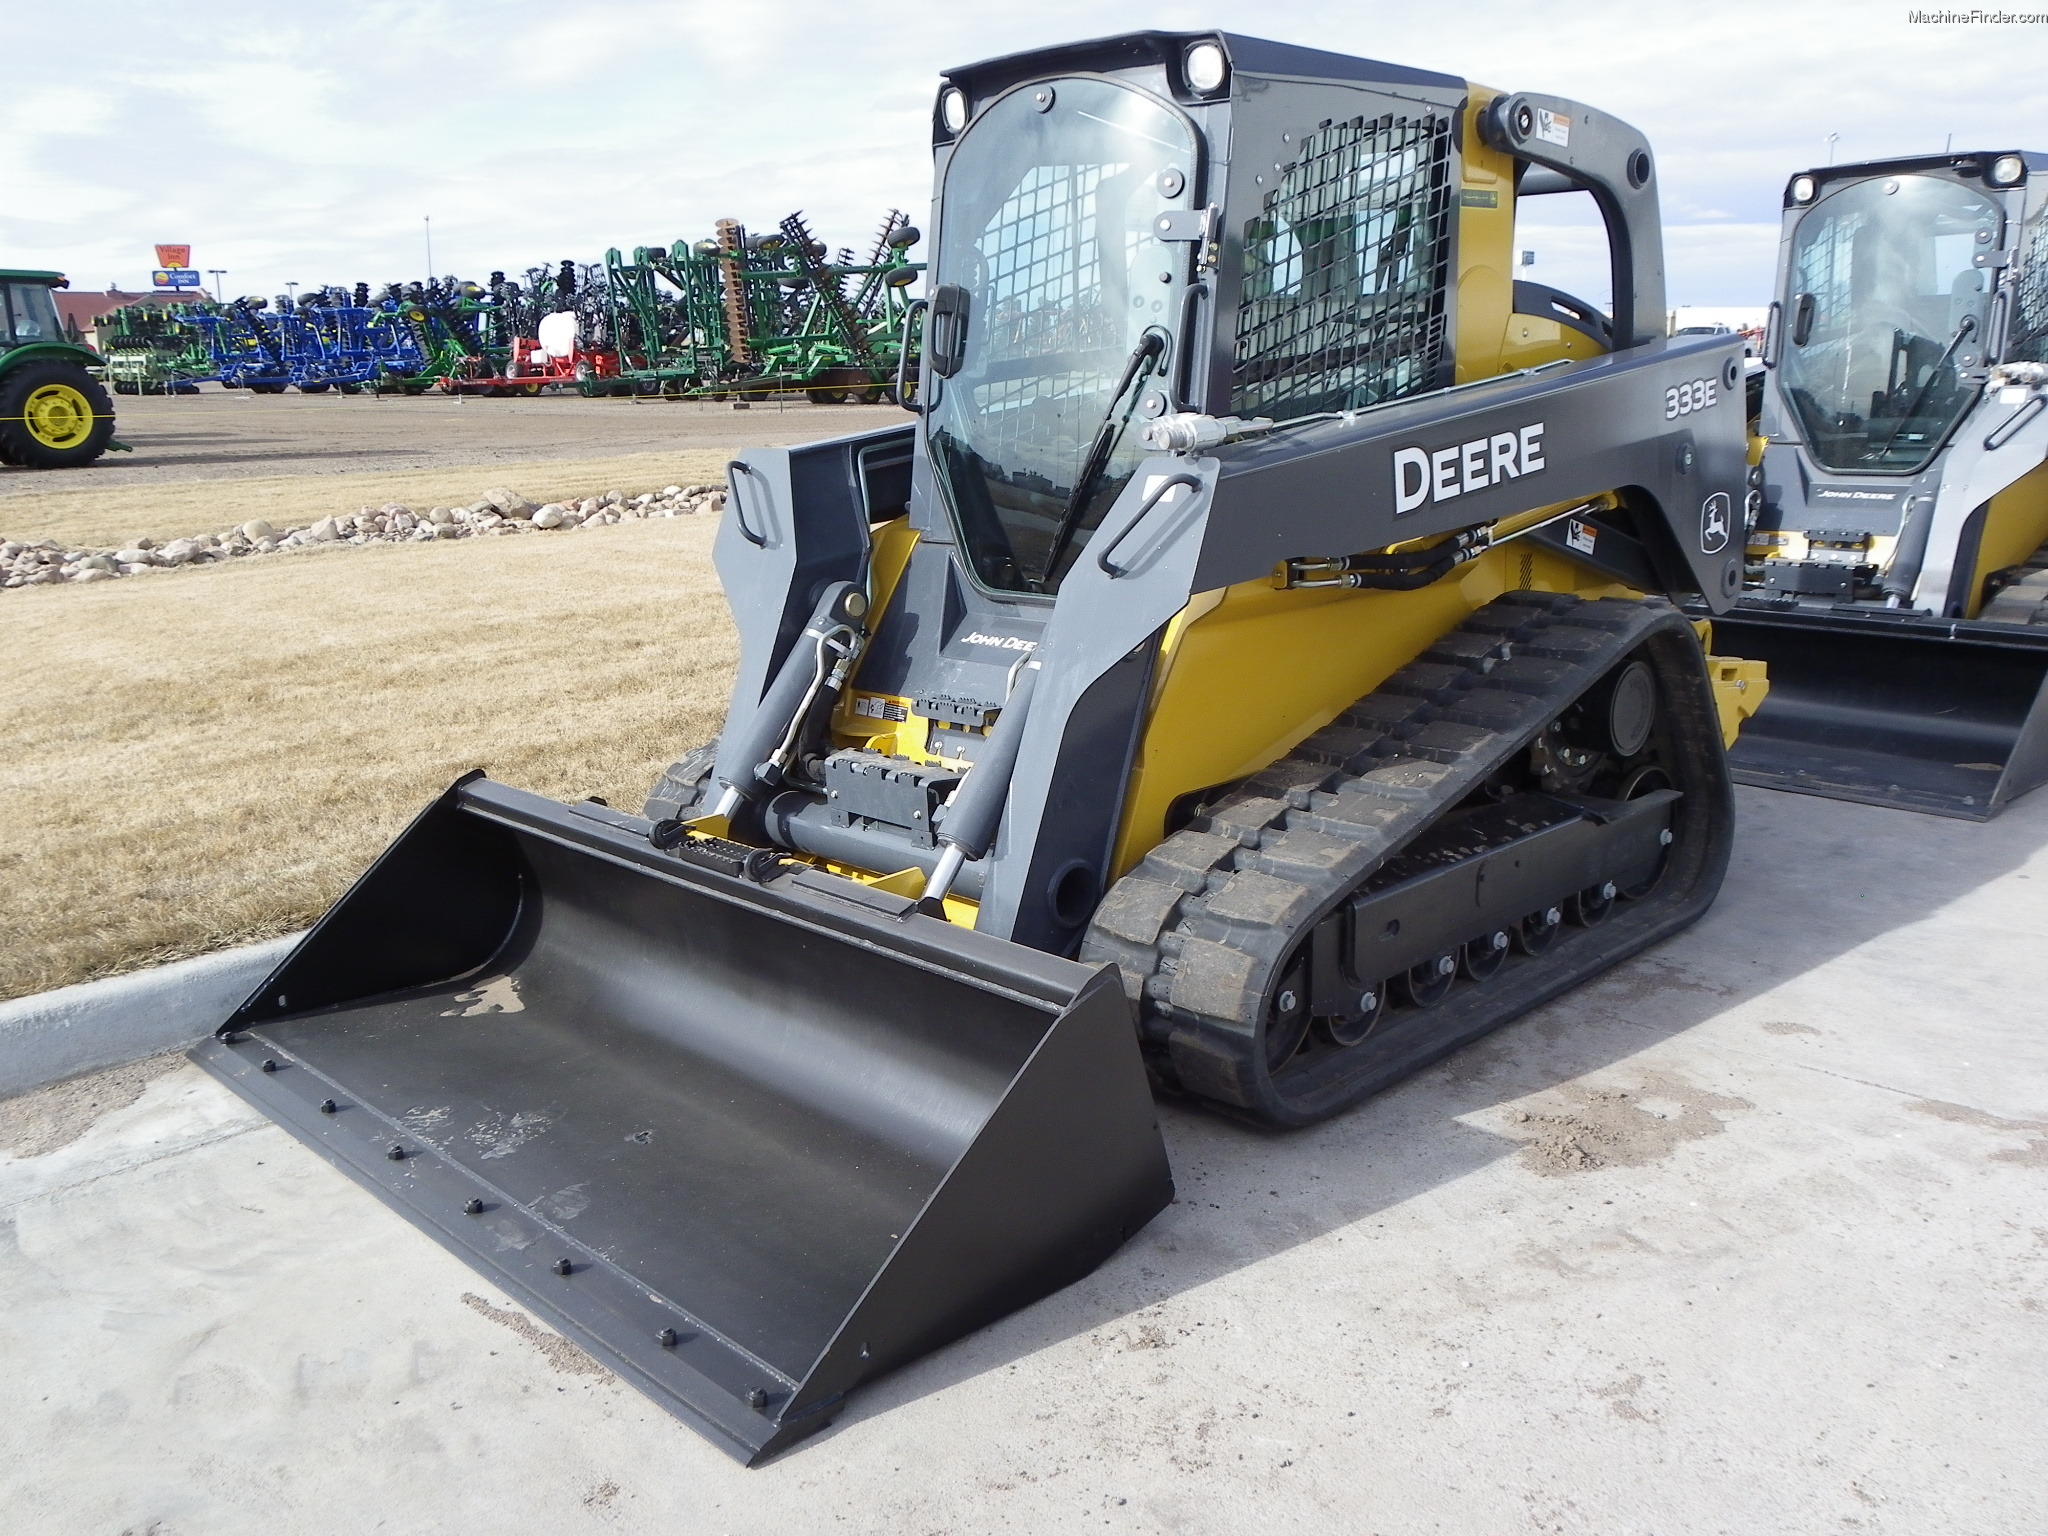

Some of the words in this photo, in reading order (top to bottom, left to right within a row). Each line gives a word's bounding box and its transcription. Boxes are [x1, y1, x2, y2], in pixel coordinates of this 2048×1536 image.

[159, 245, 186, 254] Village
[169, 272, 197, 280] Comfort
[1665, 378, 1718, 420] 333E
[1394, 422, 1546, 515] DEERE
[1817, 490, 1854, 499] JOHN
[1852, 491, 1897, 500] DEERE
[960, 631, 1005, 647] JOHN
[1001, 636, 1039, 652] DEE
